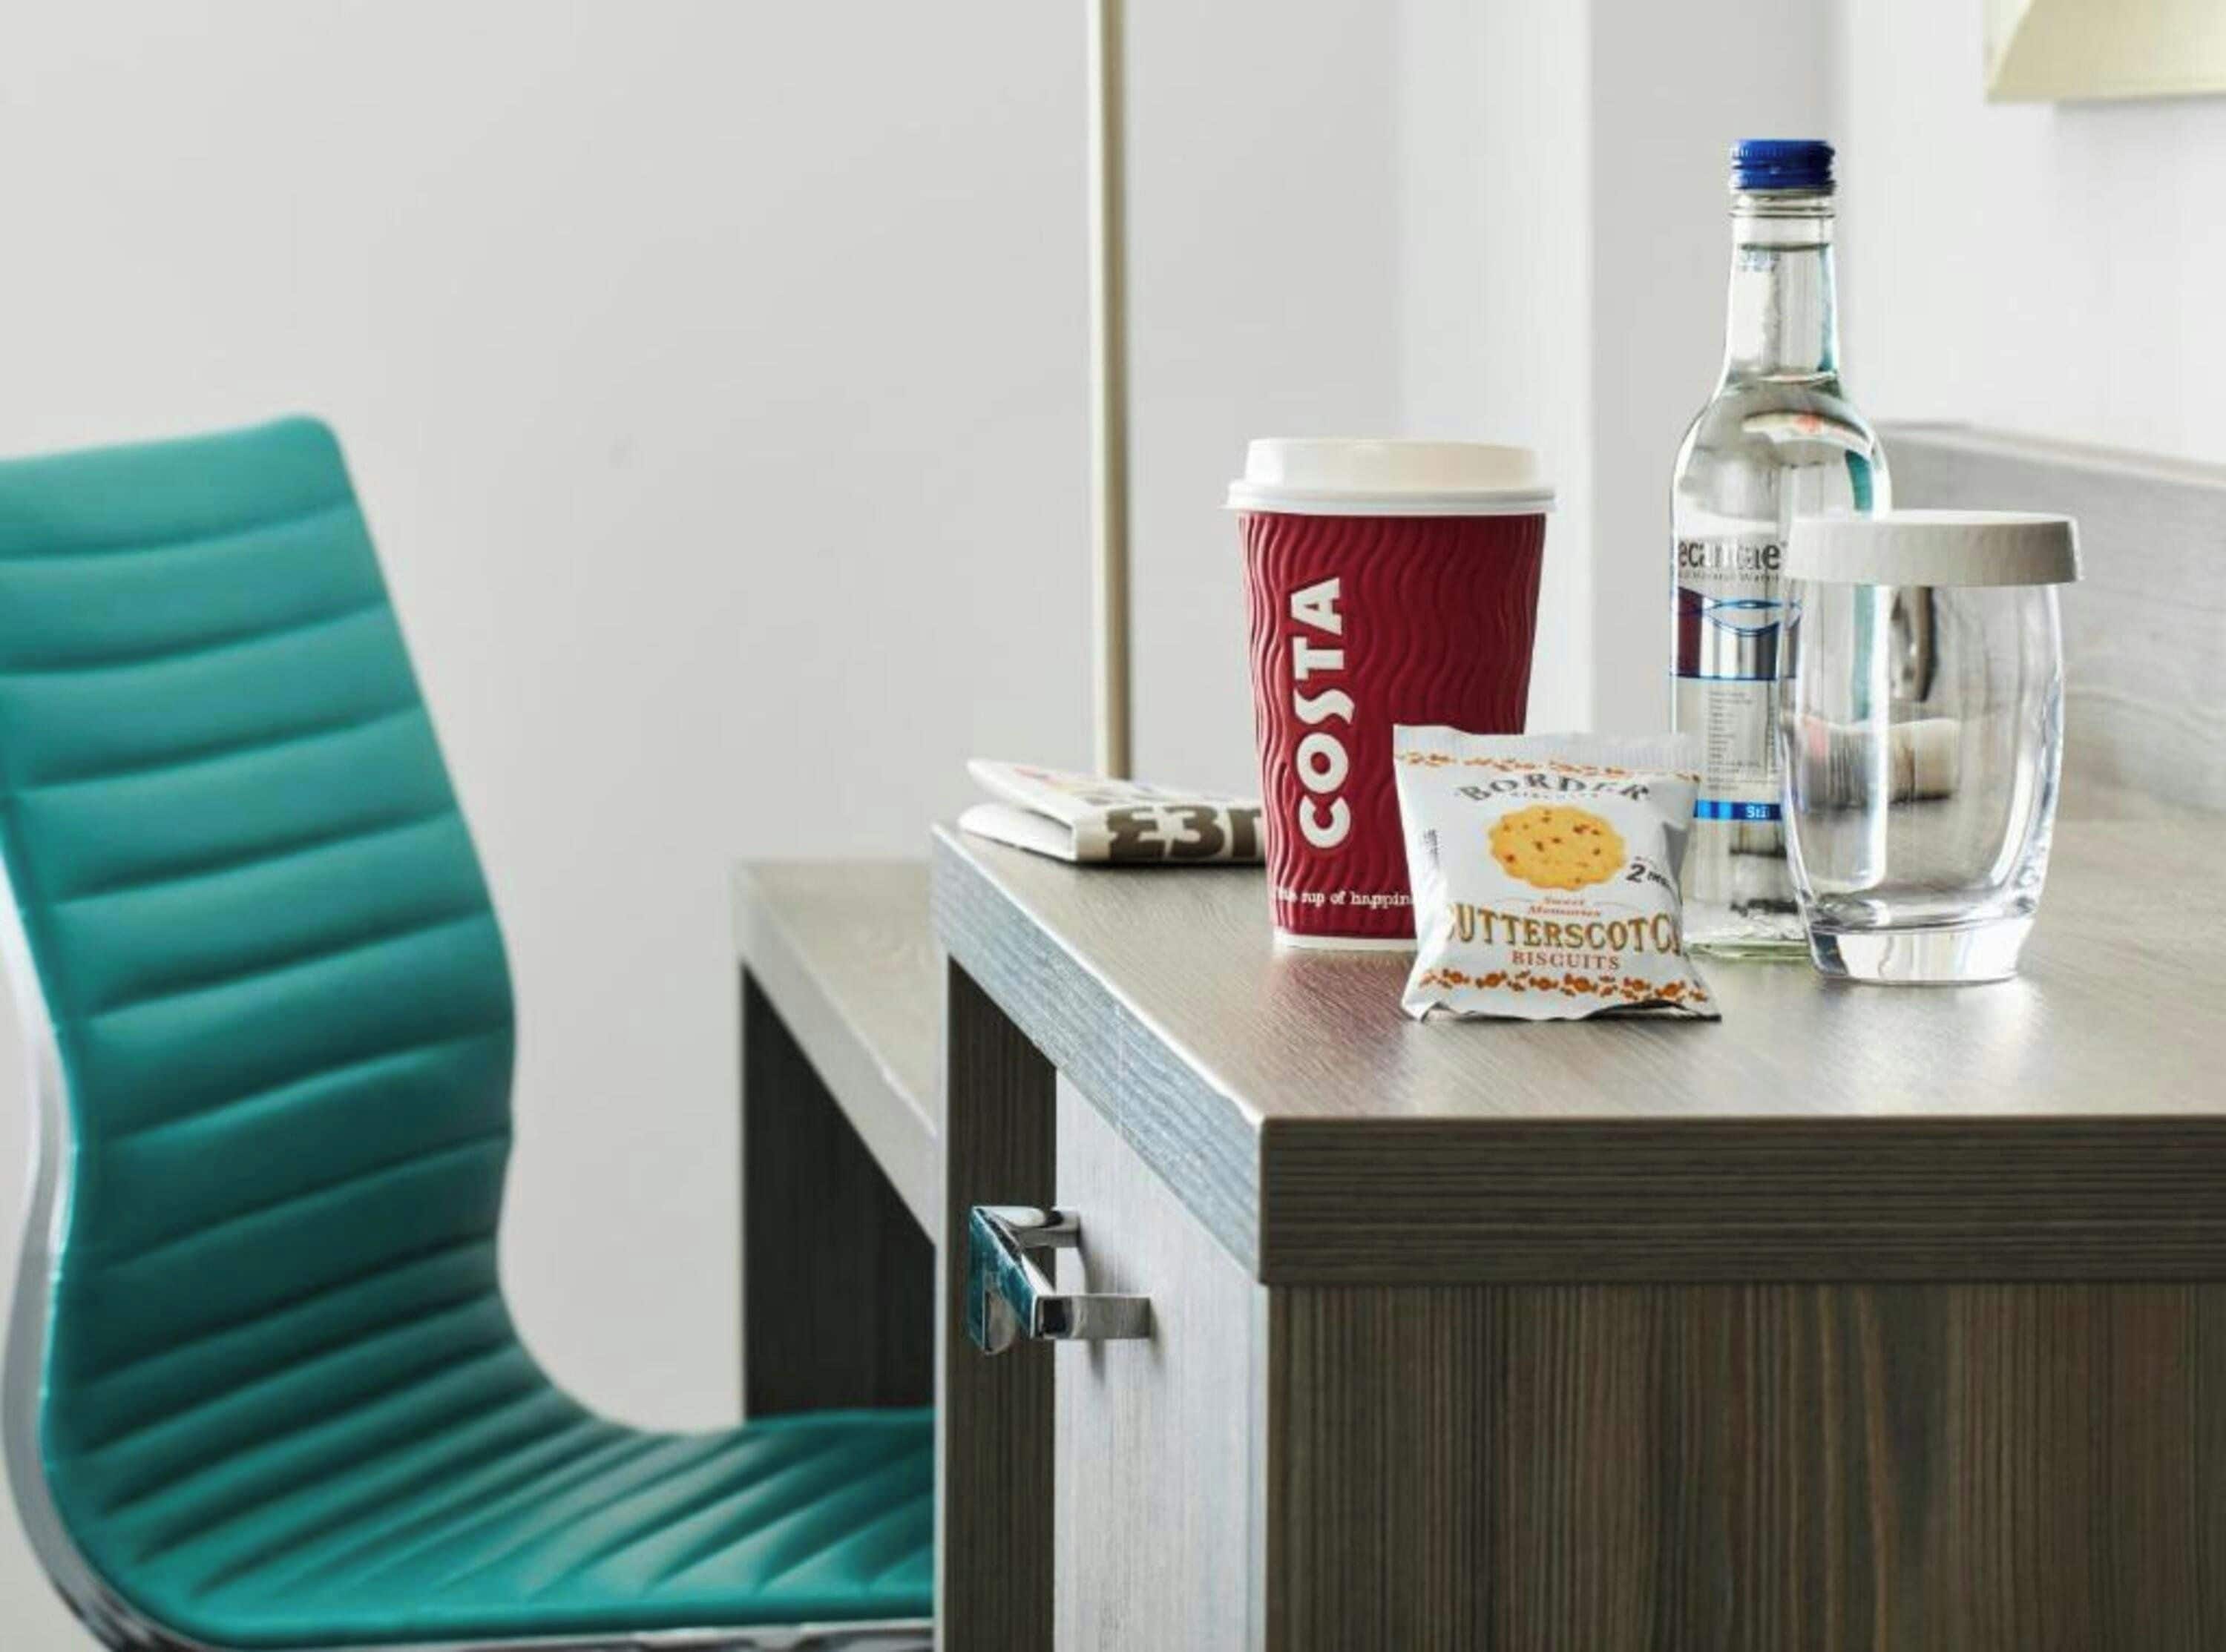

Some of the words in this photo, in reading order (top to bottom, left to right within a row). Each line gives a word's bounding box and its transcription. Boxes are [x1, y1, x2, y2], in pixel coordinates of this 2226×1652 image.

[1290, 577, 1355, 849] COSTA
[1460, 774, 1649, 800] BORDER
[1626, 863, 1646, 883] 2
[1330, 890, 1346, 905] of
[1351, 892, 1414, 909] happin
[1448, 903, 1681, 957] UTTERSCOTC
[1511, 950, 1621, 969] BISCUITS
